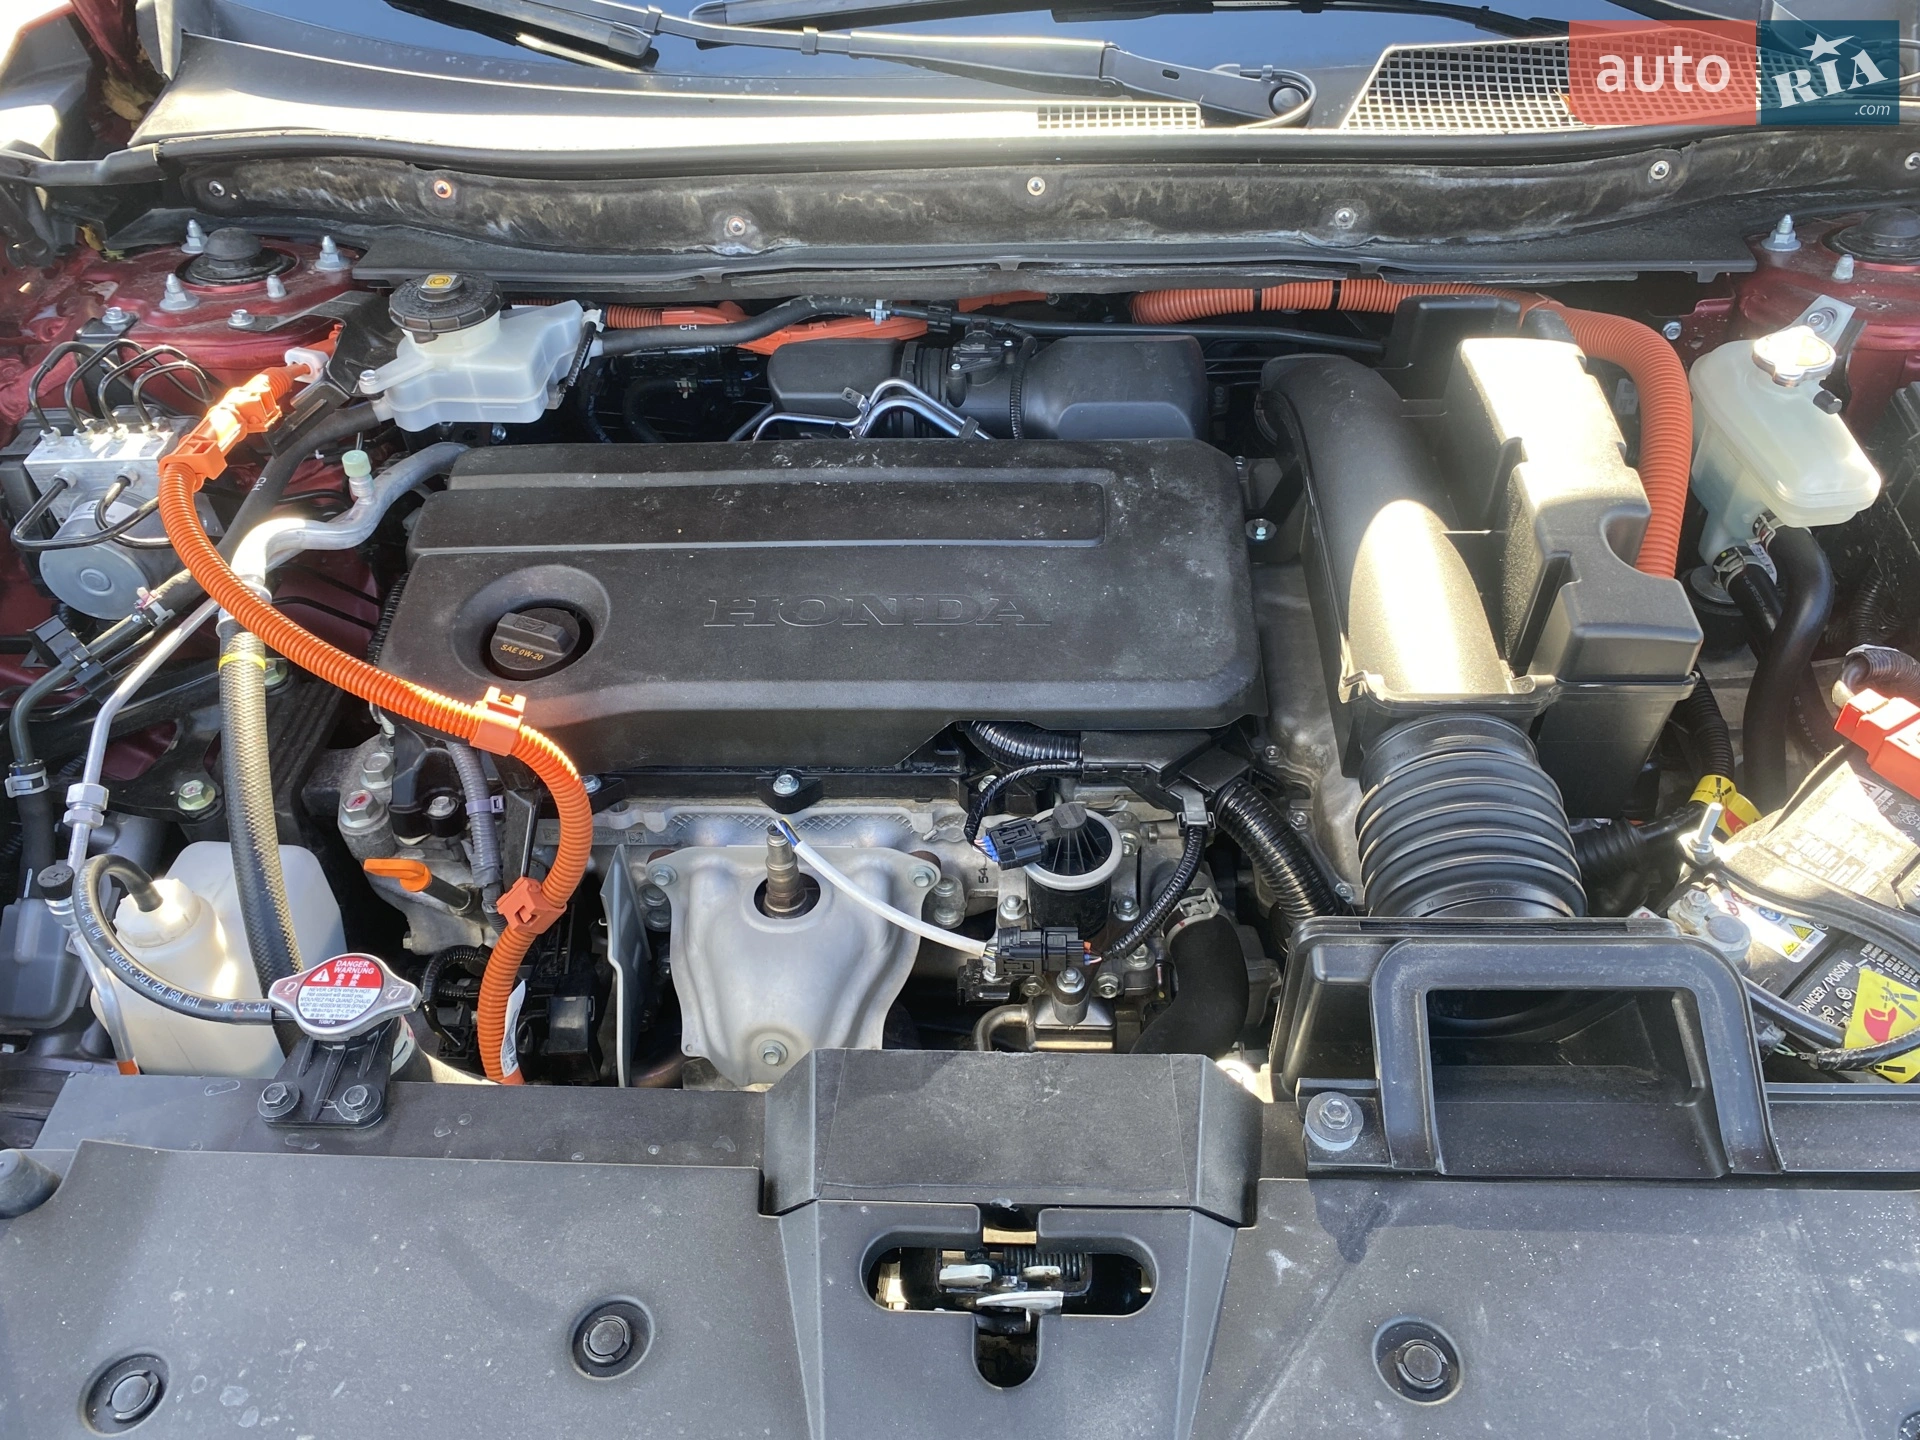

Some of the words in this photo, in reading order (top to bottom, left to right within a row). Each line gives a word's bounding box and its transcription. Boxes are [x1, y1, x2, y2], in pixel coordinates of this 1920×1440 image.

[703, 593, 1051, 627] HONDA
[500, 644, 519, 654] SAE
[518, 649, 544, 661] 0W-20
[333, 966, 375, 974] WARNUNG
[336, 960, 370, 968] DANGER
